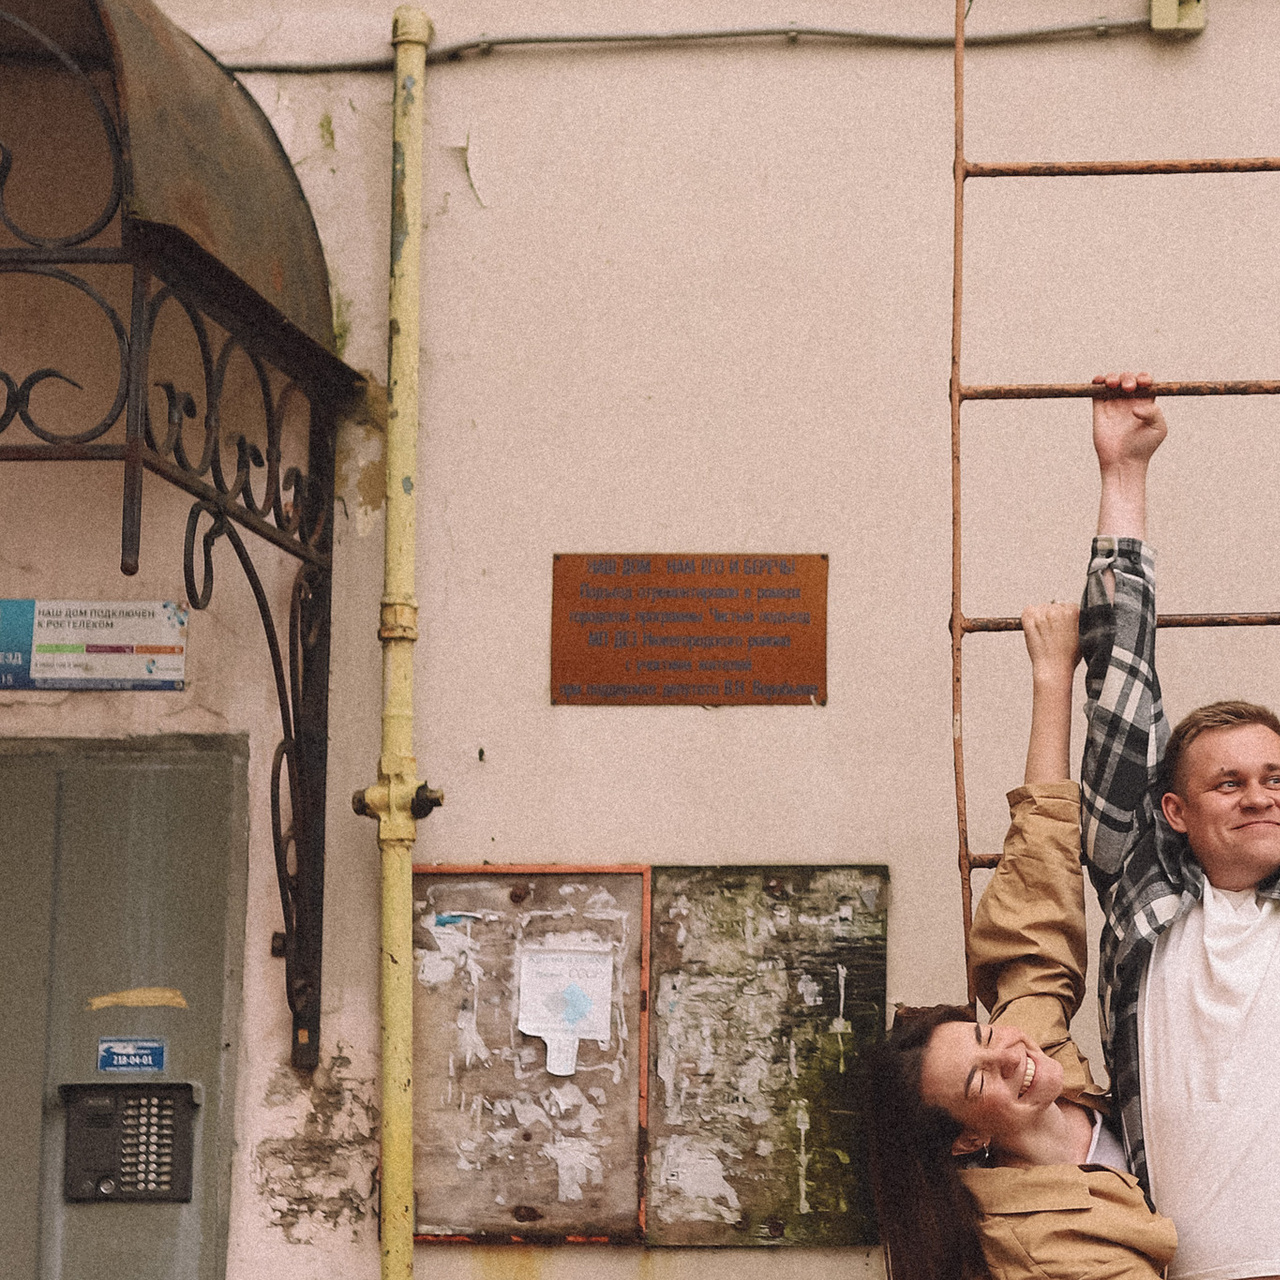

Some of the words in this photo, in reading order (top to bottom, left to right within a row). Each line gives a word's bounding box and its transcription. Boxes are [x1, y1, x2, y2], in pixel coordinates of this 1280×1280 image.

[586, 558, 617, 575] НАШ
[621, 558, 651, 576] ДОМ
[666, 558, 697, 575] НАМ
[701, 558, 725, 575] ЕГО
[728, 558, 740, 575] И
[37, 609, 62, 618] НАШ
[65, 609, 87, 619] ДОМ
[90, 609, 155, 619] ПОДКЛЮЧЕН
[37, 620, 43, 628] К
[46, 620, 114, 629] РОСТЕЛЕКОМ
